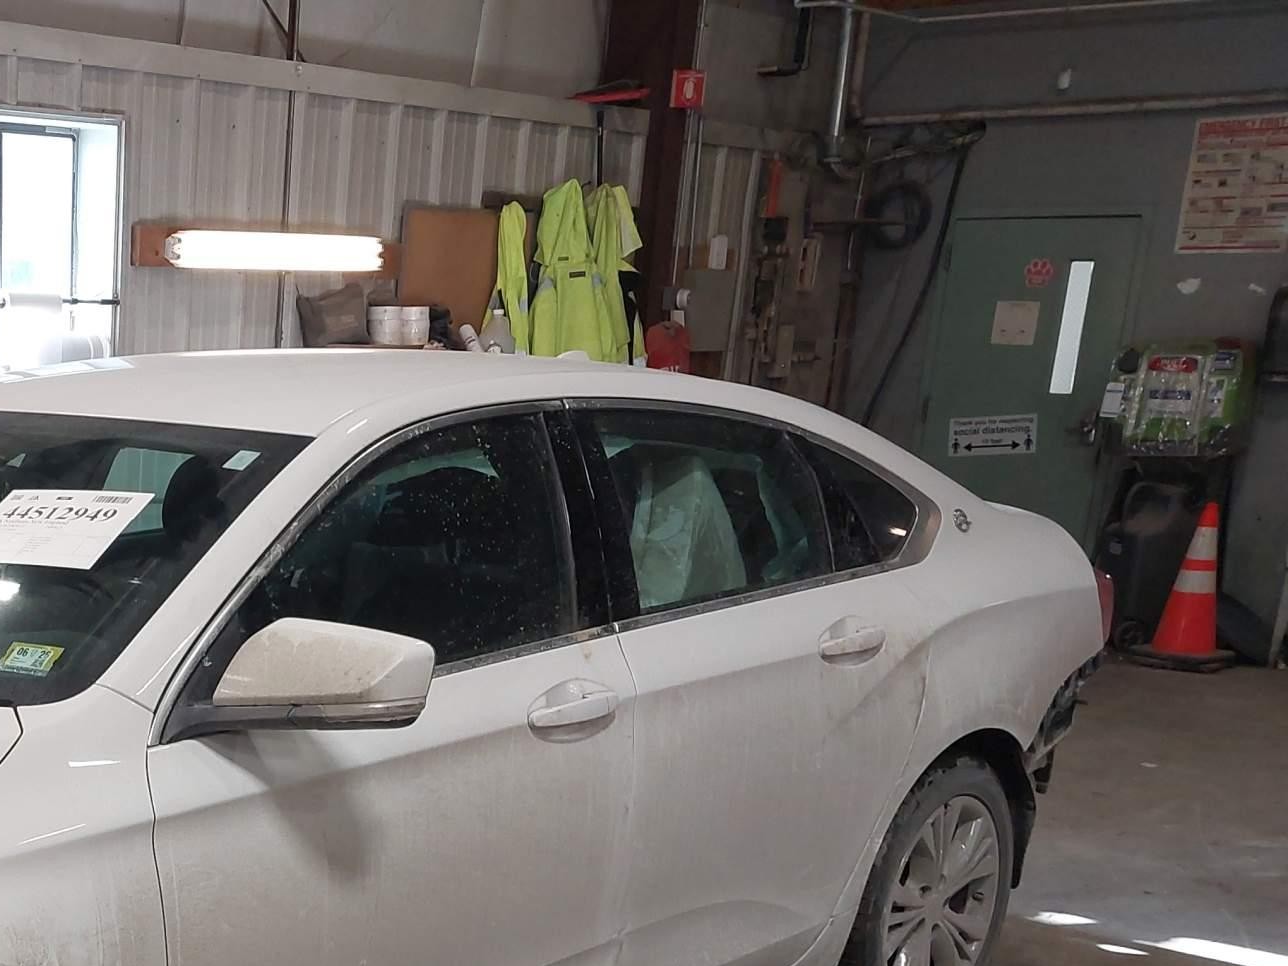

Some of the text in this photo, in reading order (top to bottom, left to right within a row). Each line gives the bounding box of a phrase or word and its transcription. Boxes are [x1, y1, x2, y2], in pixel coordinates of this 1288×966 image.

[953, 427, 980, 436] social
[3, 505, 118, 521] 44512949
[16, 647, 30, 657] 06
